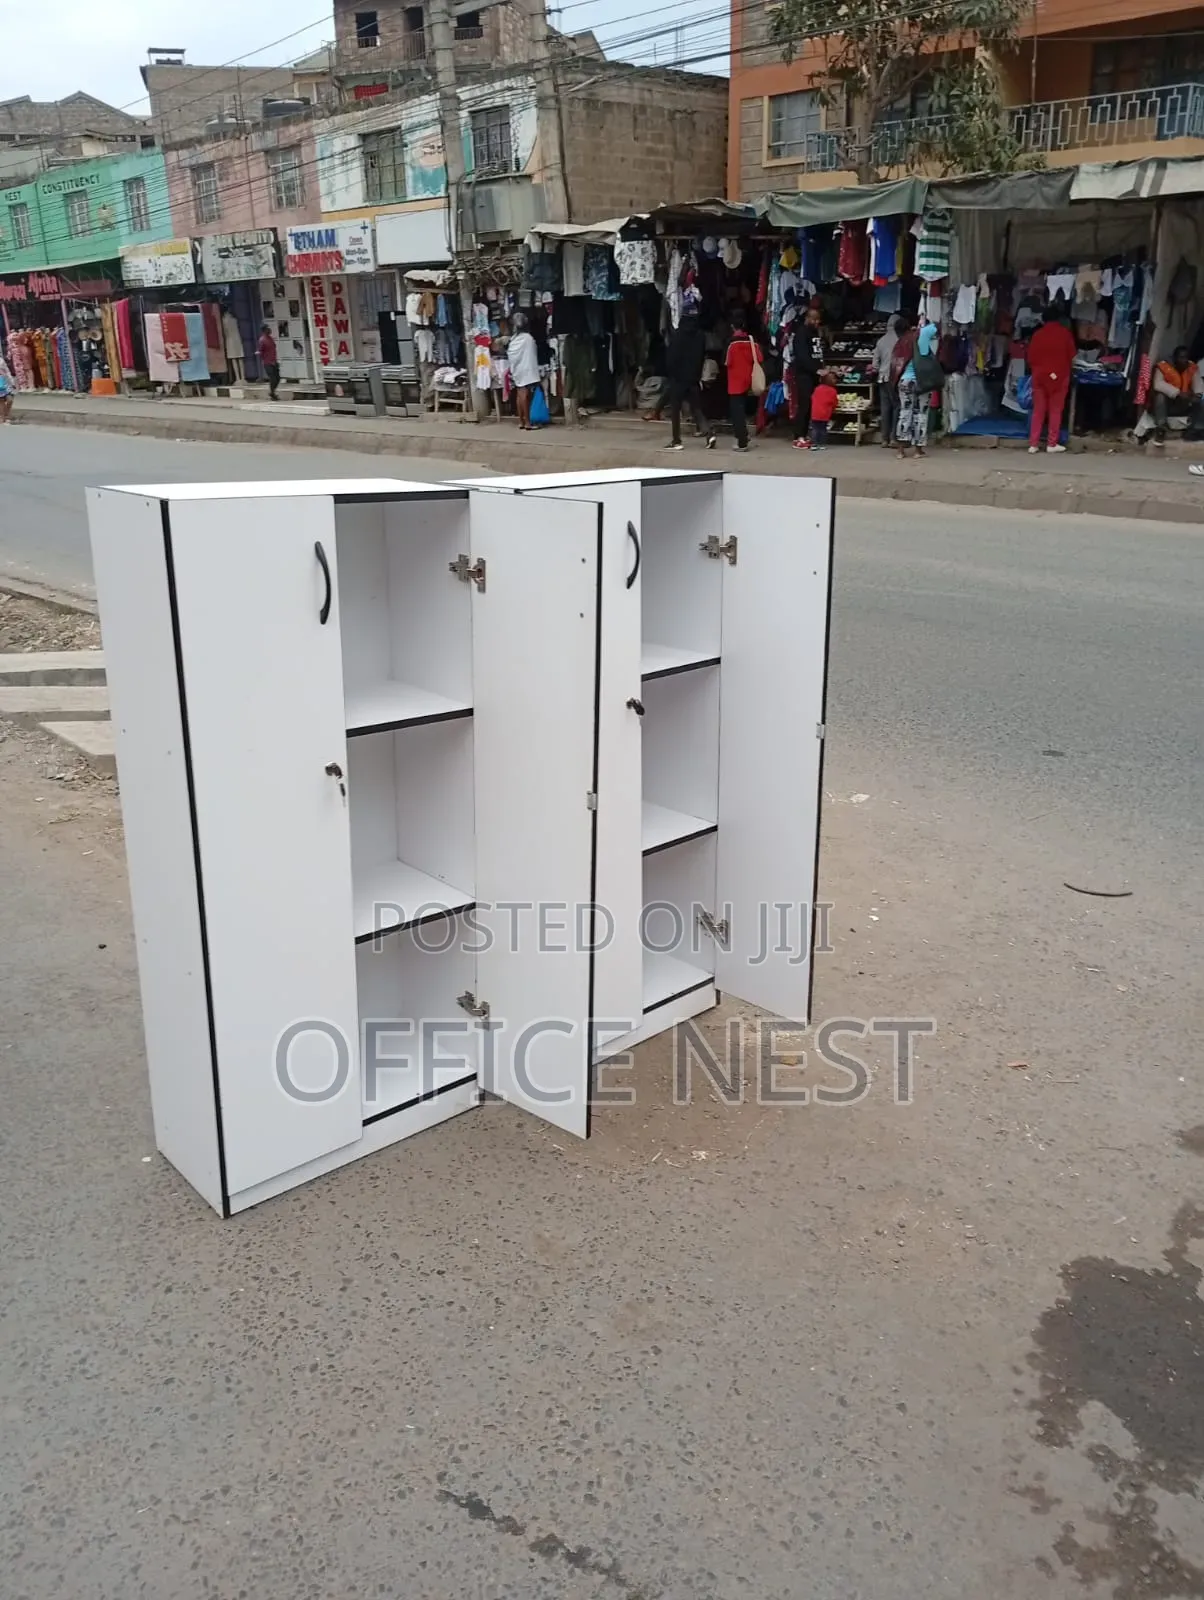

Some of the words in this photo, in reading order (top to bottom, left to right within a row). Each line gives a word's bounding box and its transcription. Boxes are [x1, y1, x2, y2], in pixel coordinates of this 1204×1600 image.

[42, 174, 100, 194] CONSTITUENCY
[310, 275, 331, 366] CHEMIST
[331, 281, 350, 356] DAWA
